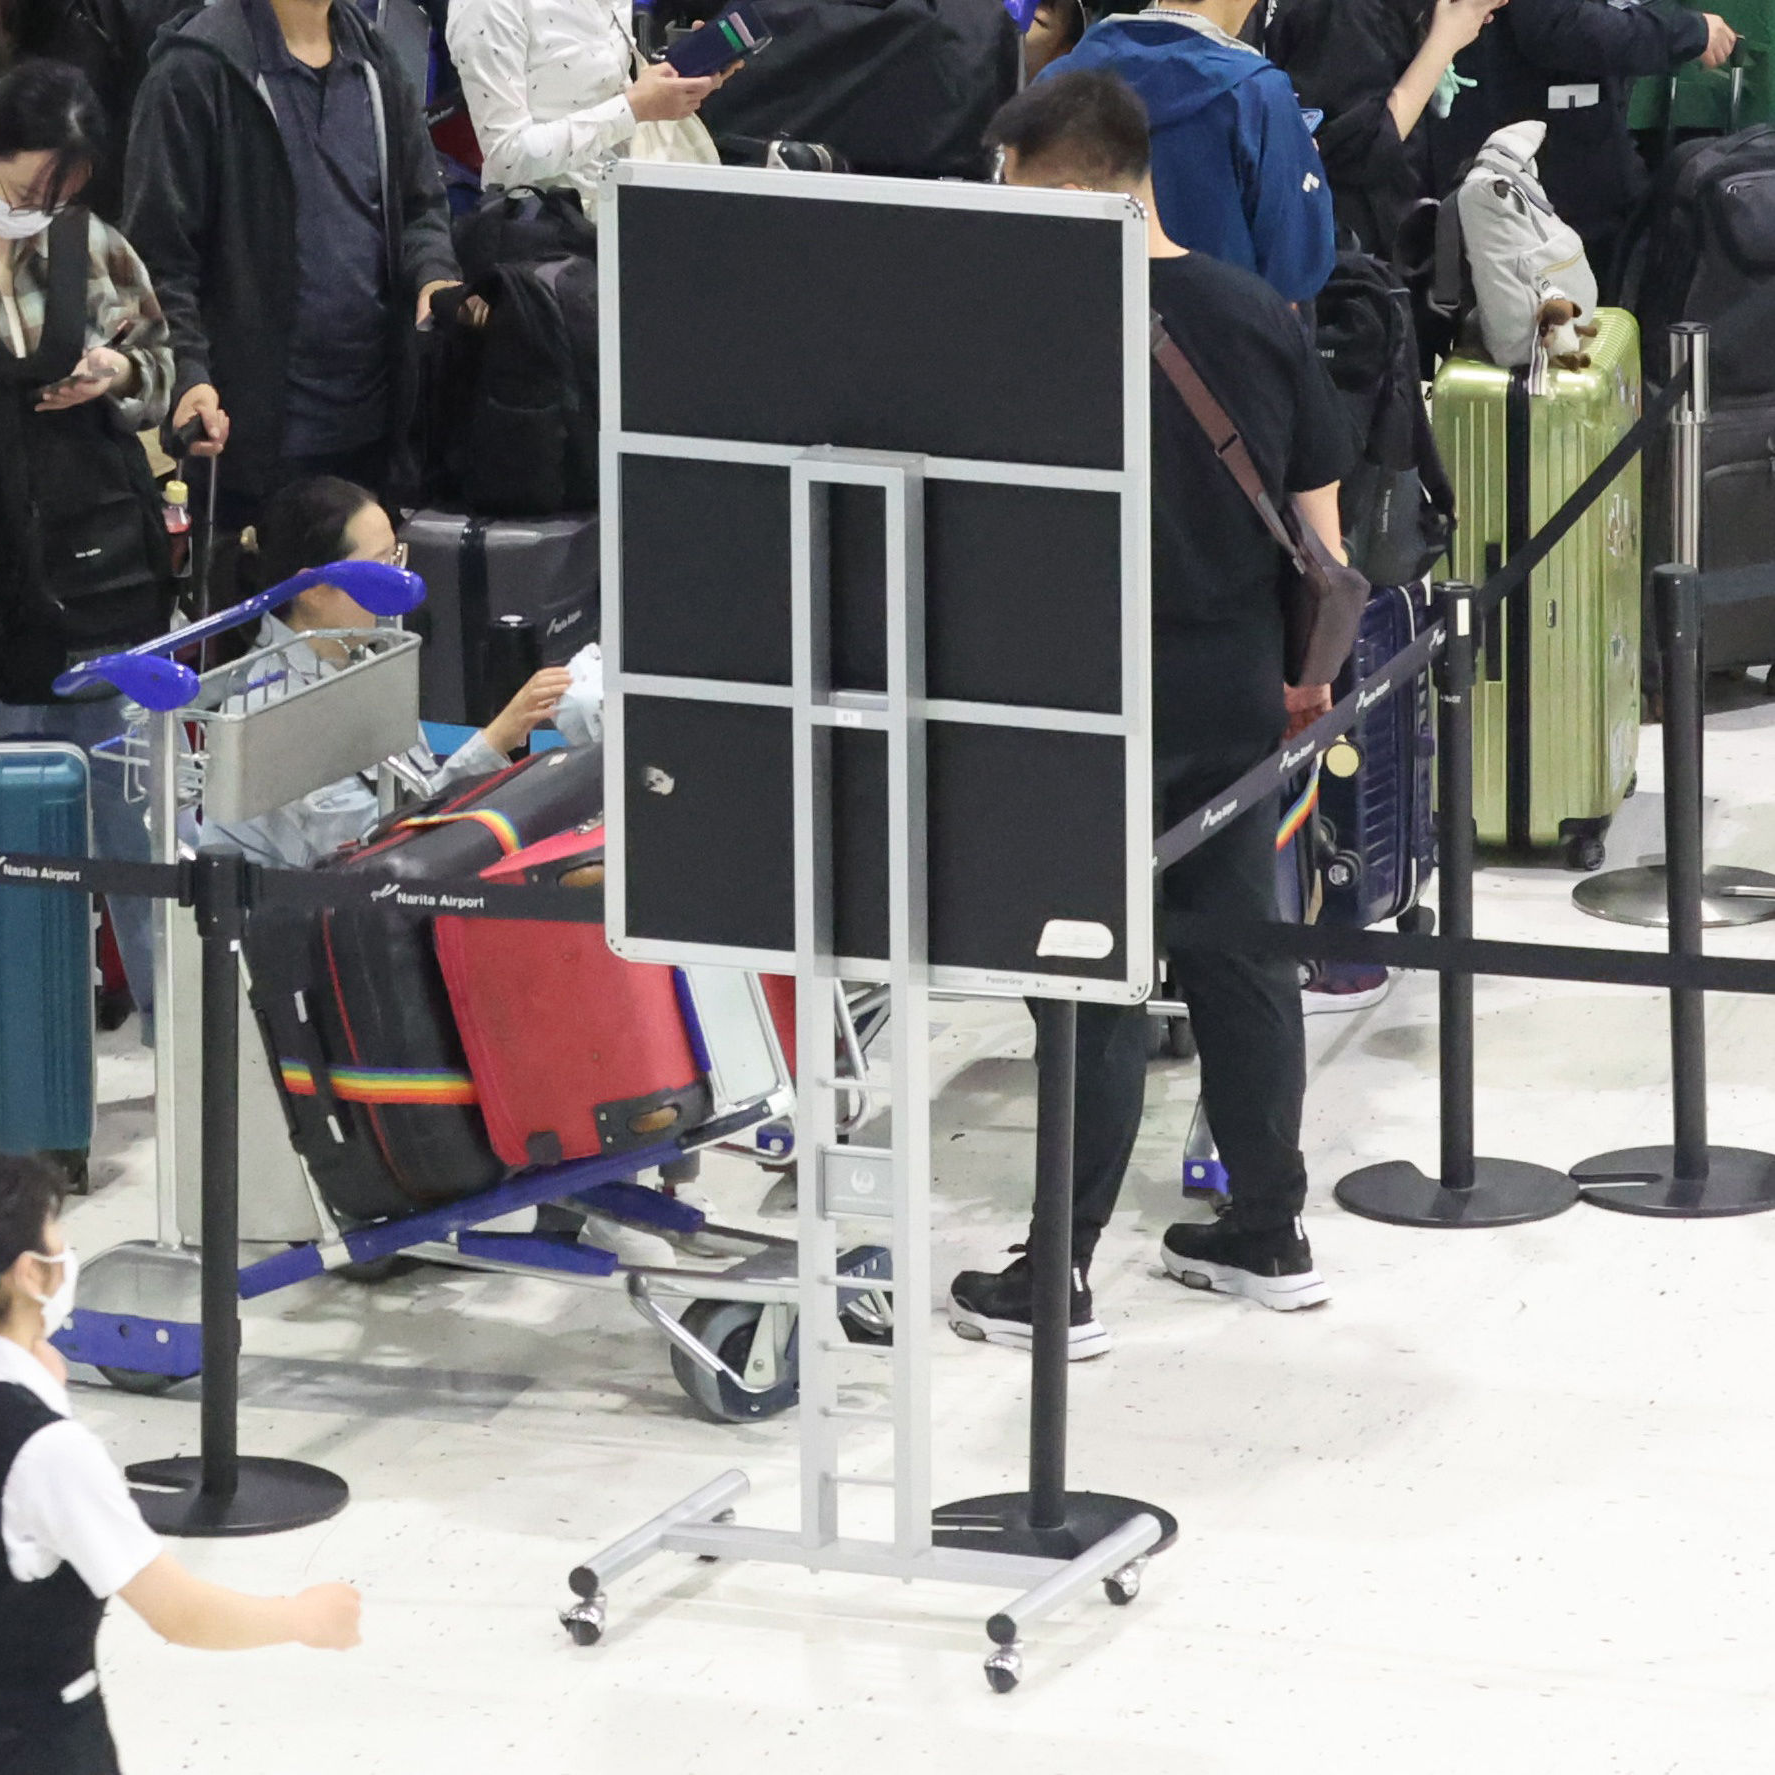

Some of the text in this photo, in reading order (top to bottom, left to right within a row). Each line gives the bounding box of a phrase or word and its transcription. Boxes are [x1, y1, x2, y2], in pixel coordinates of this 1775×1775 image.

[3, 863, 80, 882] Narita Airport
[397, 892, 485, 910] Narita Airport
